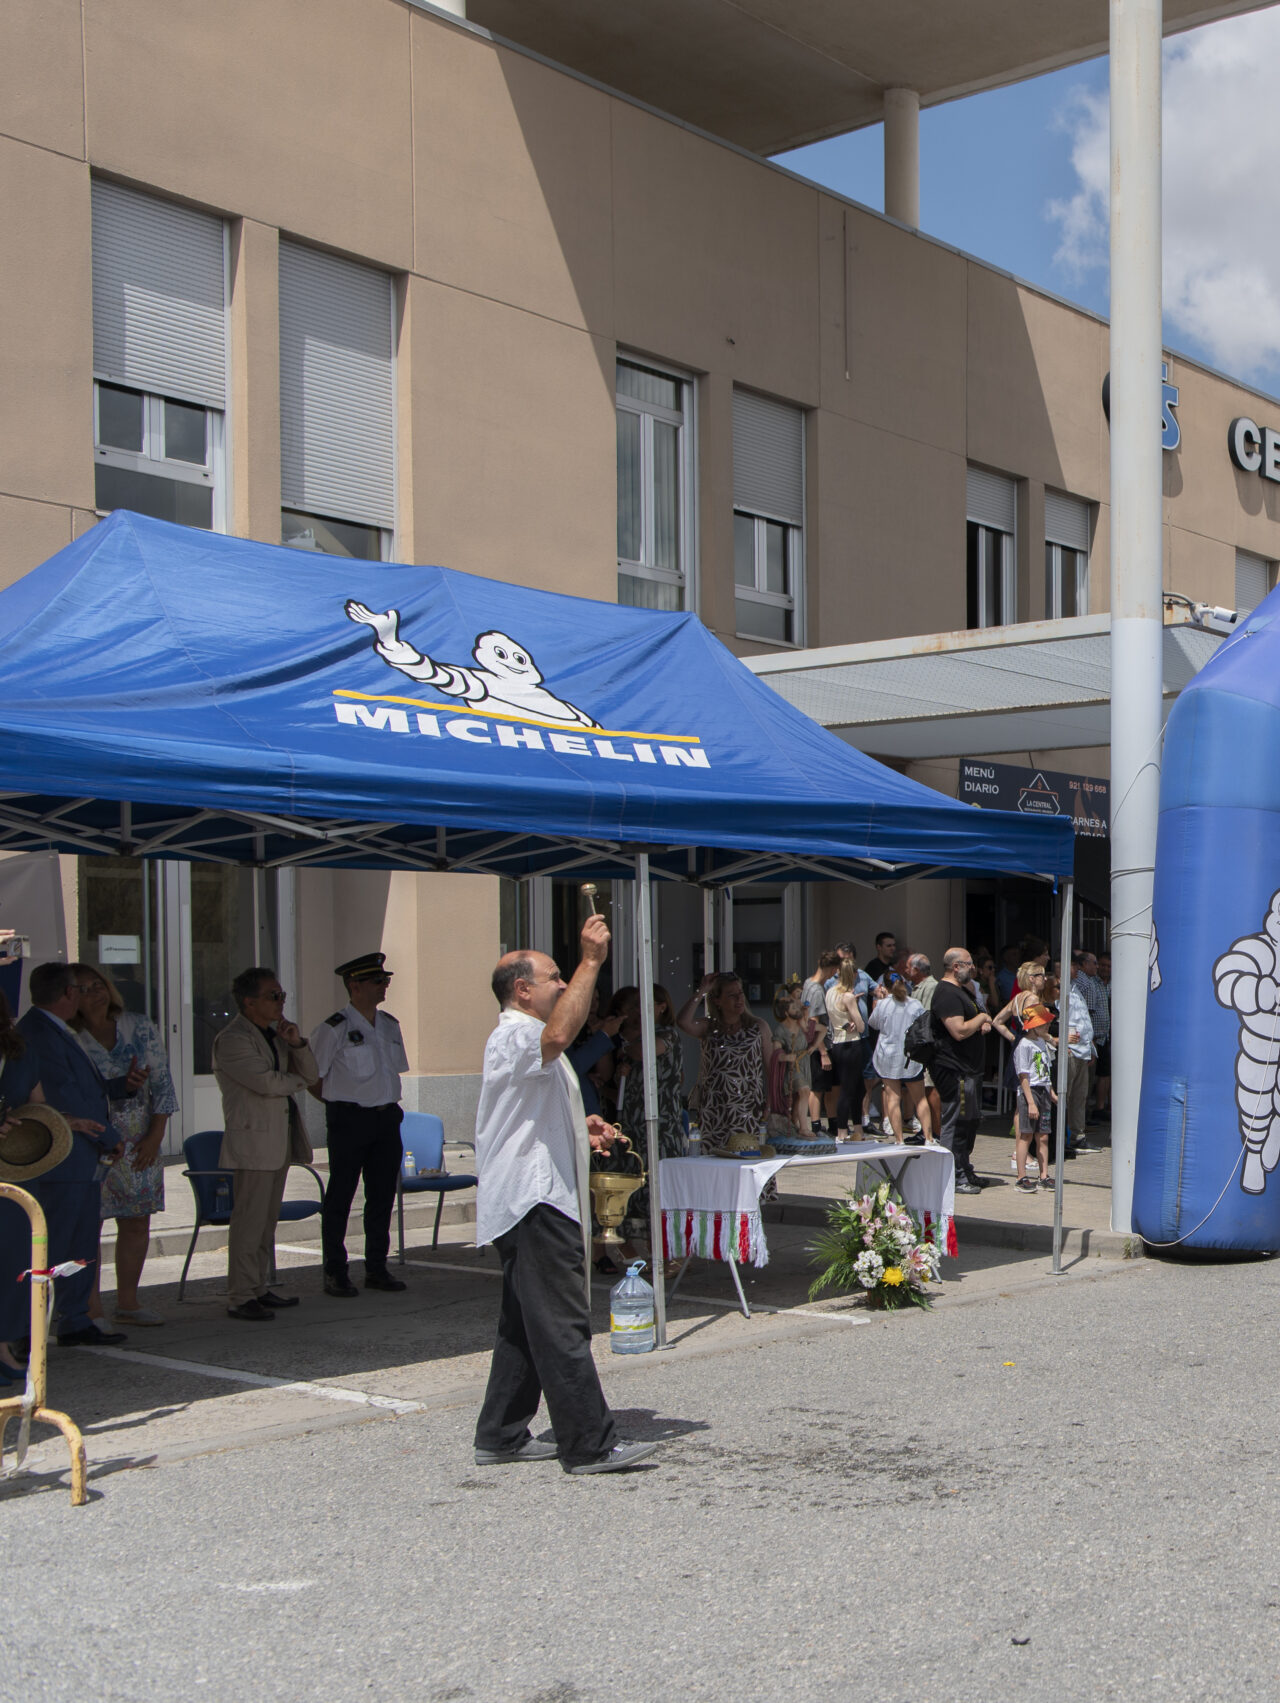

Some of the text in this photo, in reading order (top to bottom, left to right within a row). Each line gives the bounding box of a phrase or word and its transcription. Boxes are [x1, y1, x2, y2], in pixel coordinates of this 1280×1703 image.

[333, 702, 711, 768] MICHELIN
[964, 766, 995, 779] MENÚ
[964, 781, 1000, 795] DIARIO
[1033, 800, 1052, 809] CENTRAL
[1071, 816, 1107, 829] ARNES A
